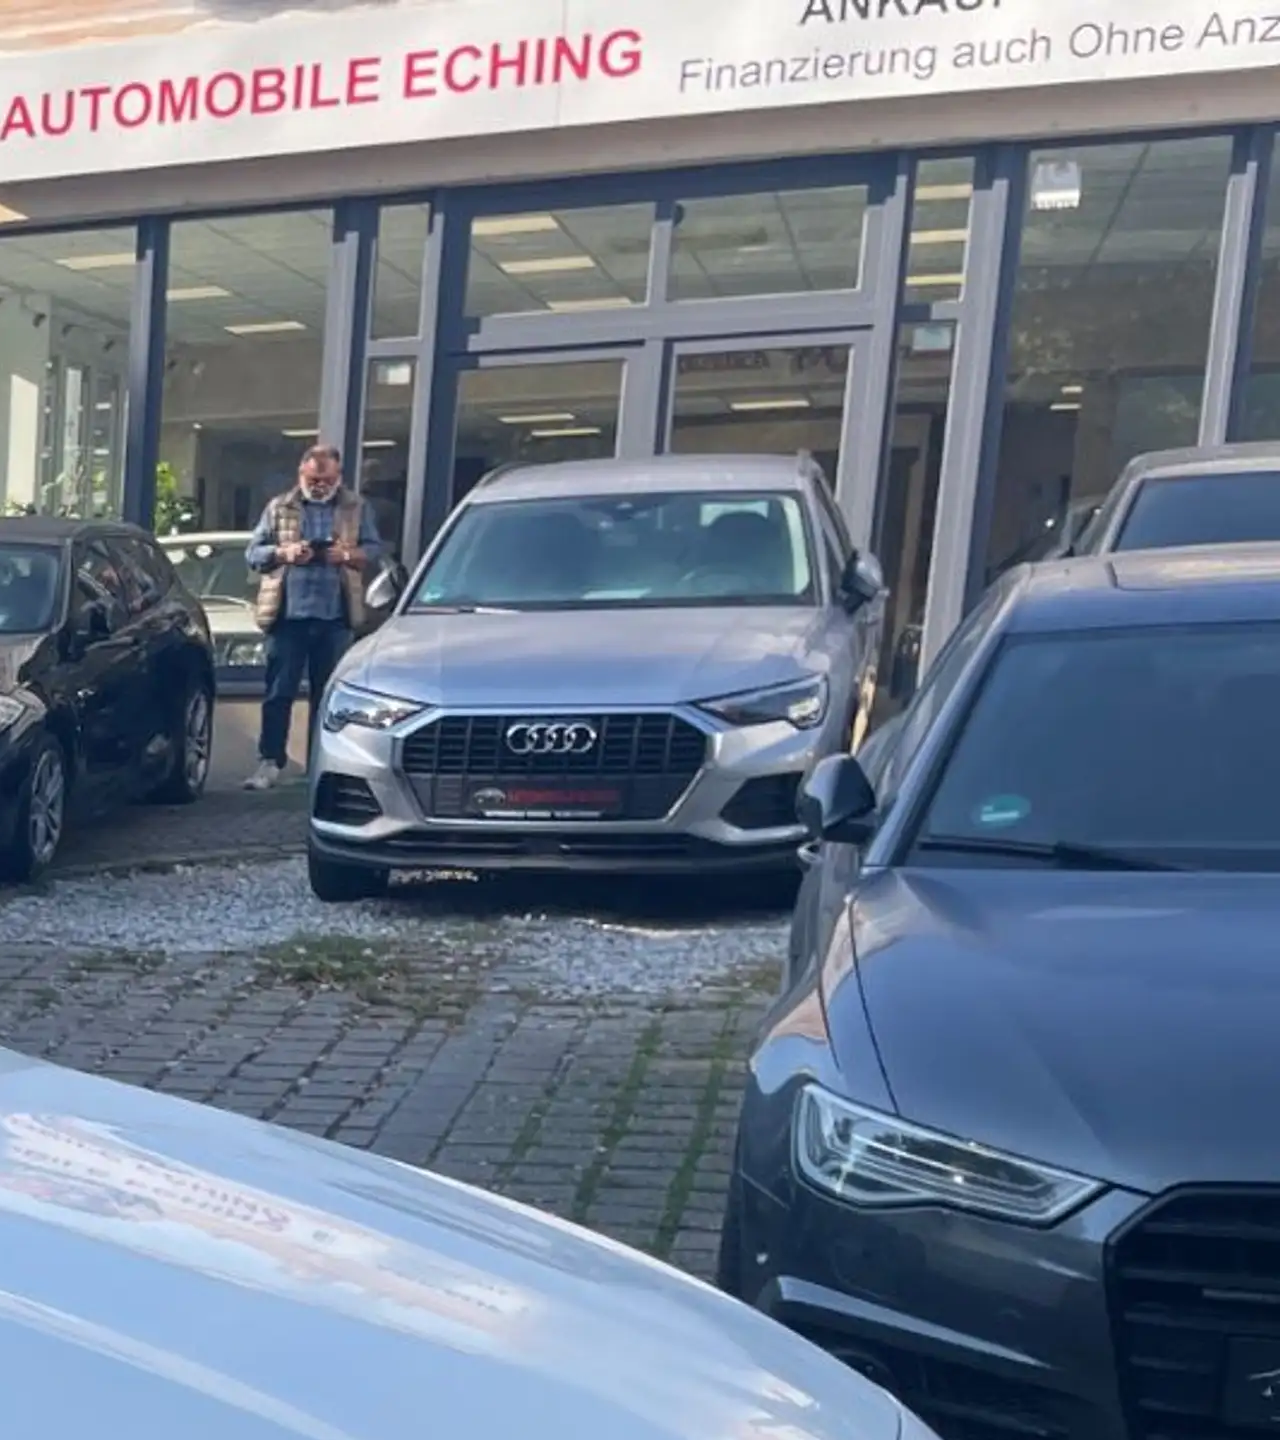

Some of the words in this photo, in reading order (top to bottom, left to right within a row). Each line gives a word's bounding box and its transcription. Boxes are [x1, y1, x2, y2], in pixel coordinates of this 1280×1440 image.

[0, 56, 382, 141] AUTOMOBILE
[403, 29, 643, 99] ECHING
[679, 45, 938, 93] Finanzierung
[953, 28, 1052, 69] auch
[1069, 22, 1185, 59] Ohne
[1197, 12, 1280, 49] Anz
